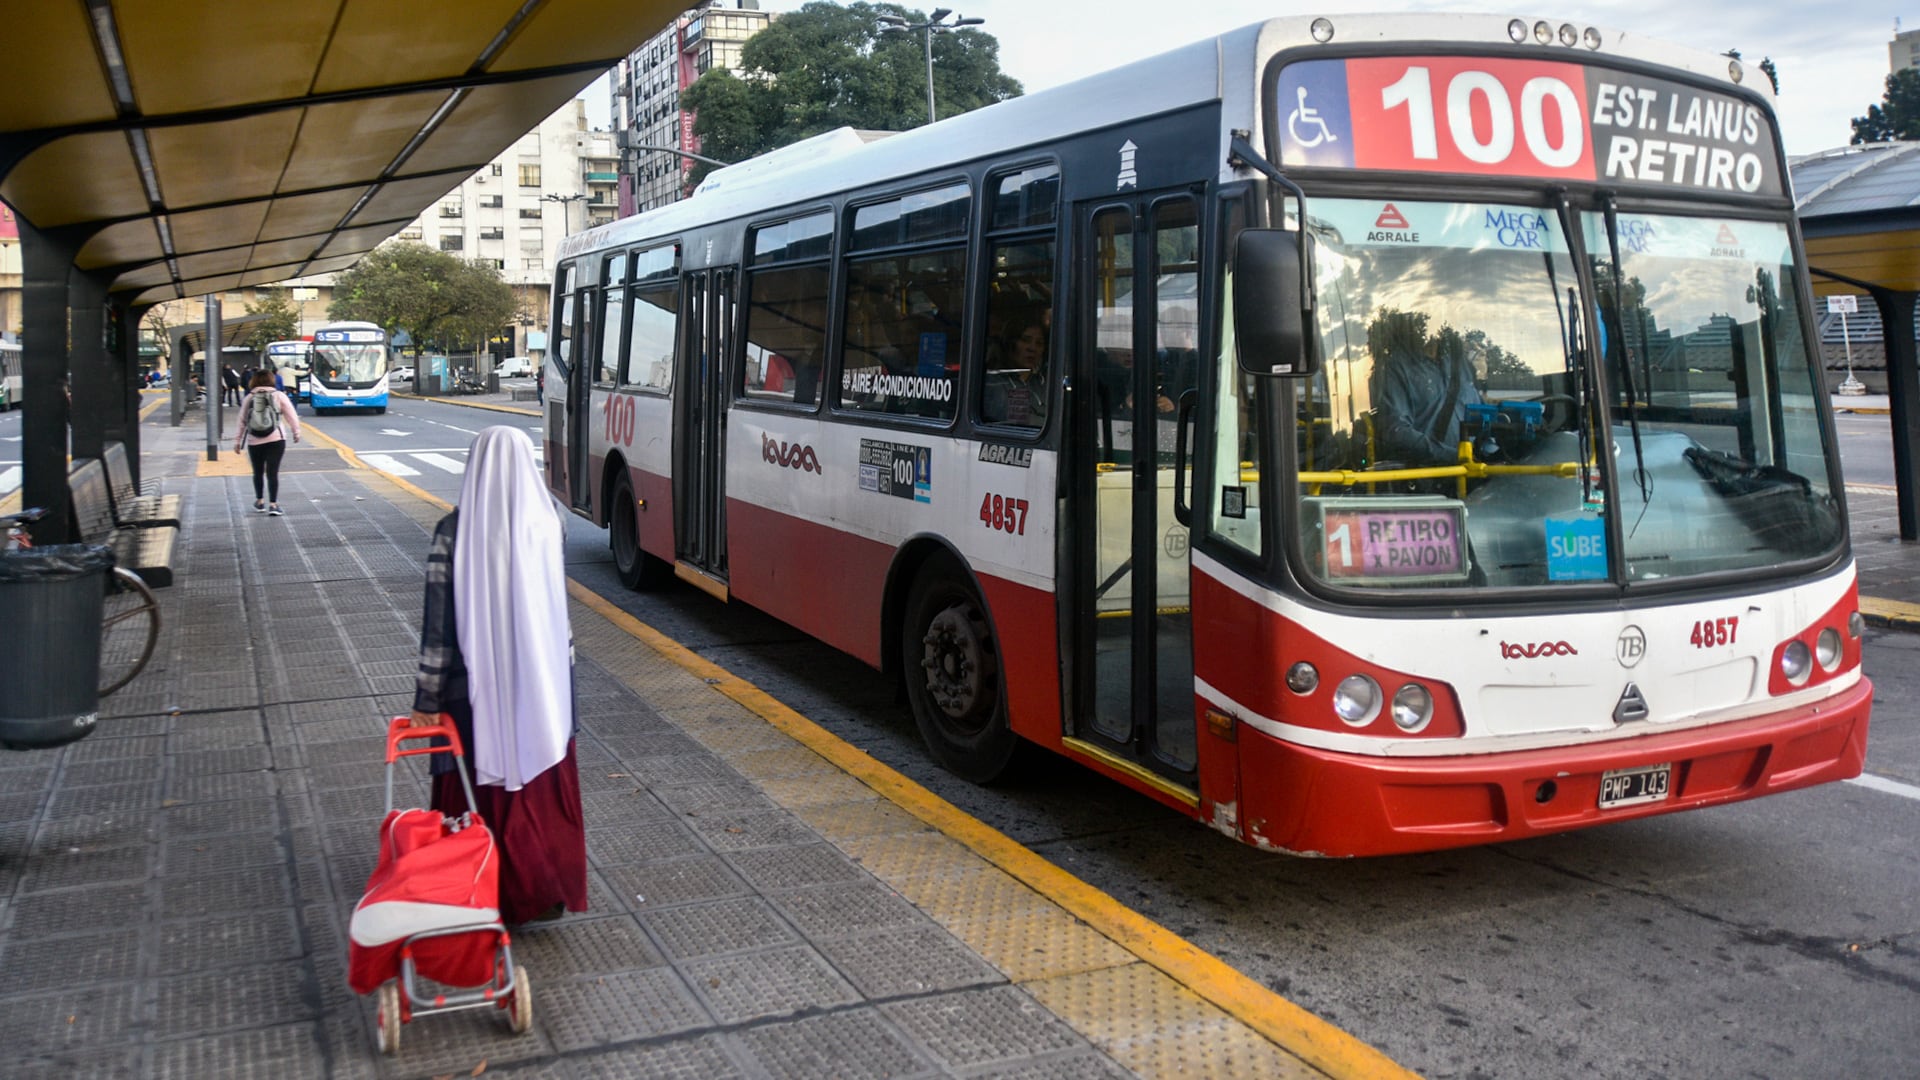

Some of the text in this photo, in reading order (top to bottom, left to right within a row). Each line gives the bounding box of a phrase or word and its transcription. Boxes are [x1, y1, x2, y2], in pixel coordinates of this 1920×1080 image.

[1382, 66, 1583, 168] 100
[1593, 83, 1759, 145] EST. LANUS
[1605, 135, 1763, 193] RETIRO
[1485, 209, 1549, 231] MEGA
[1367, 231, 1419, 242] AGRALE
[1497, 227, 1542, 248] CAR
[851, 373, 952, 402] AIRE ACONDICIONADO
[603, 393, 635, 447] 100
[892, 443, 914, 454] LINEA
[980, 443, 1032, 467] AGRALE
[893, 458, 913, 486] 100
[980, 492, 1029, 536] 4857
[1368, 519, 1449, 543] RETIRO
[1328, 523, 1353, 568] 1
[1389, 546, 1450, 567] PAVON
[1551, 534, 1602, 557] SUBE
[1690, 616, 1739, 648] 4857
[1619, 635, 1643, 659] TB
[1603, 771, 1667, 800] PMP 143
